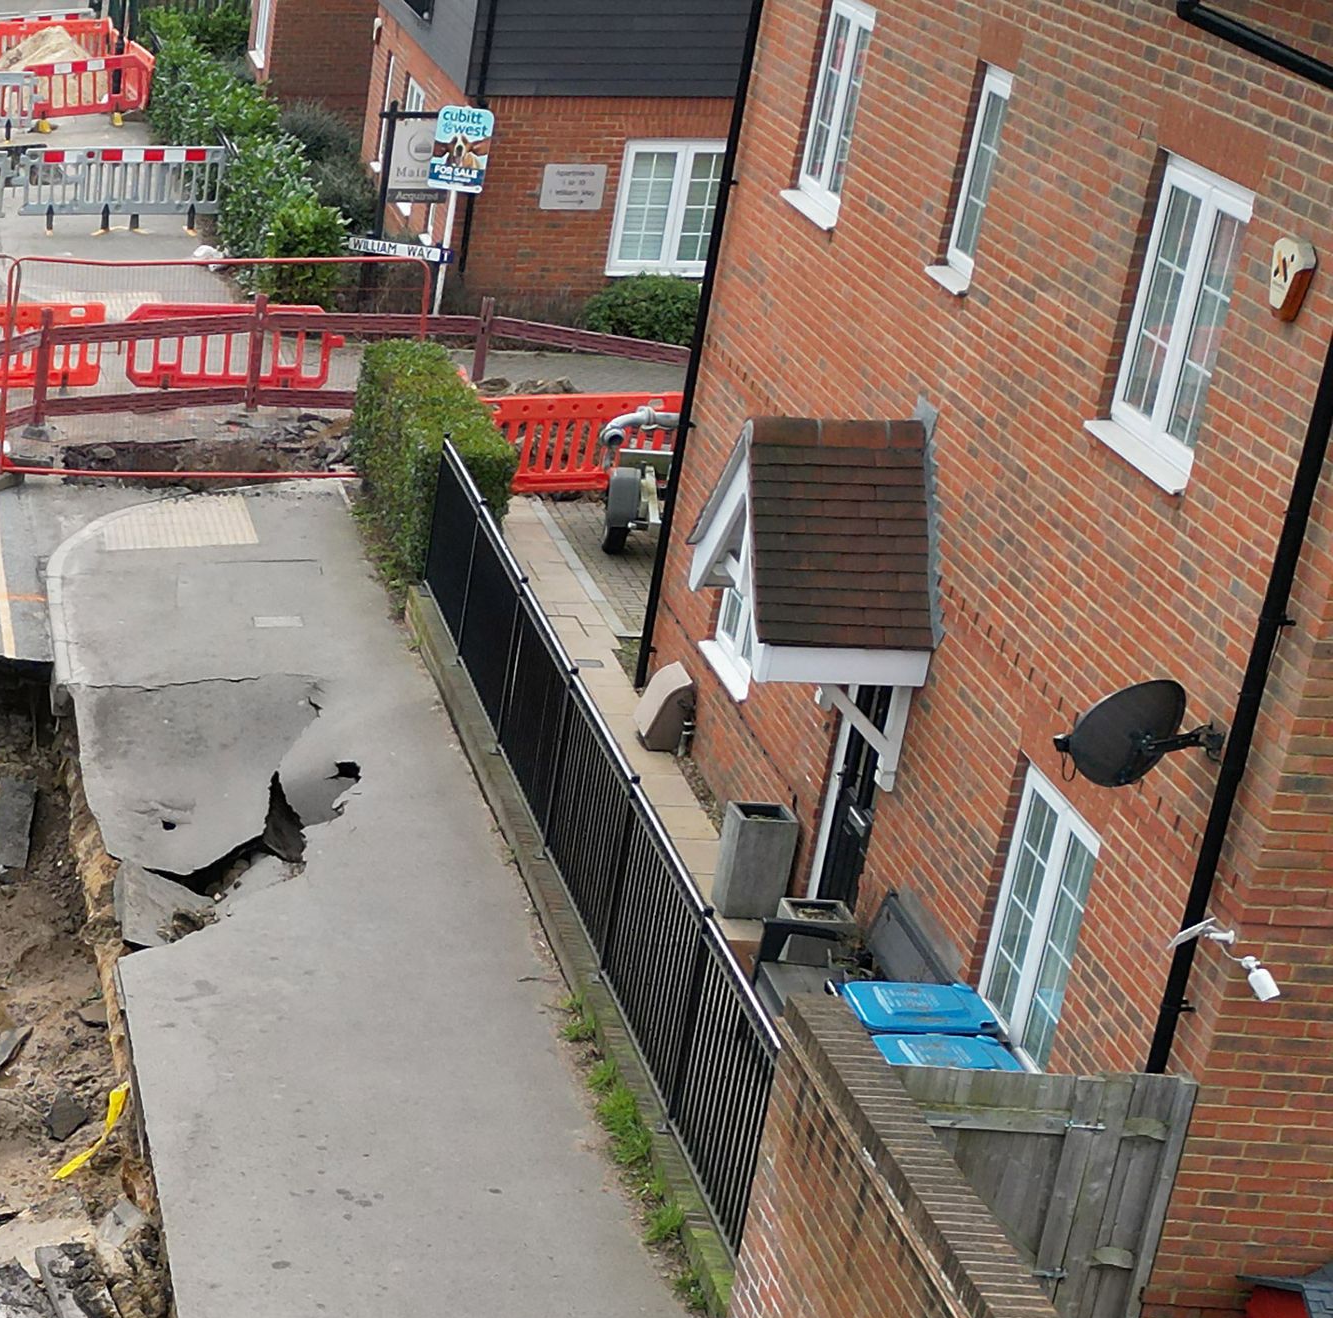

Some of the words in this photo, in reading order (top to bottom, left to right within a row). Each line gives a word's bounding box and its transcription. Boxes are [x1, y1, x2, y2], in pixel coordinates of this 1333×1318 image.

[443, 109, 483, 124] cubitt
[454, 123, 488, 137] west
[434, 164, 453, 176] FOR
[453, 167, 478, 179] SALE
[395, 190, 439, 202] Acquired
[353, 239, 397, 255] WILLIAM
[407, 246, 433, 259] WAY
